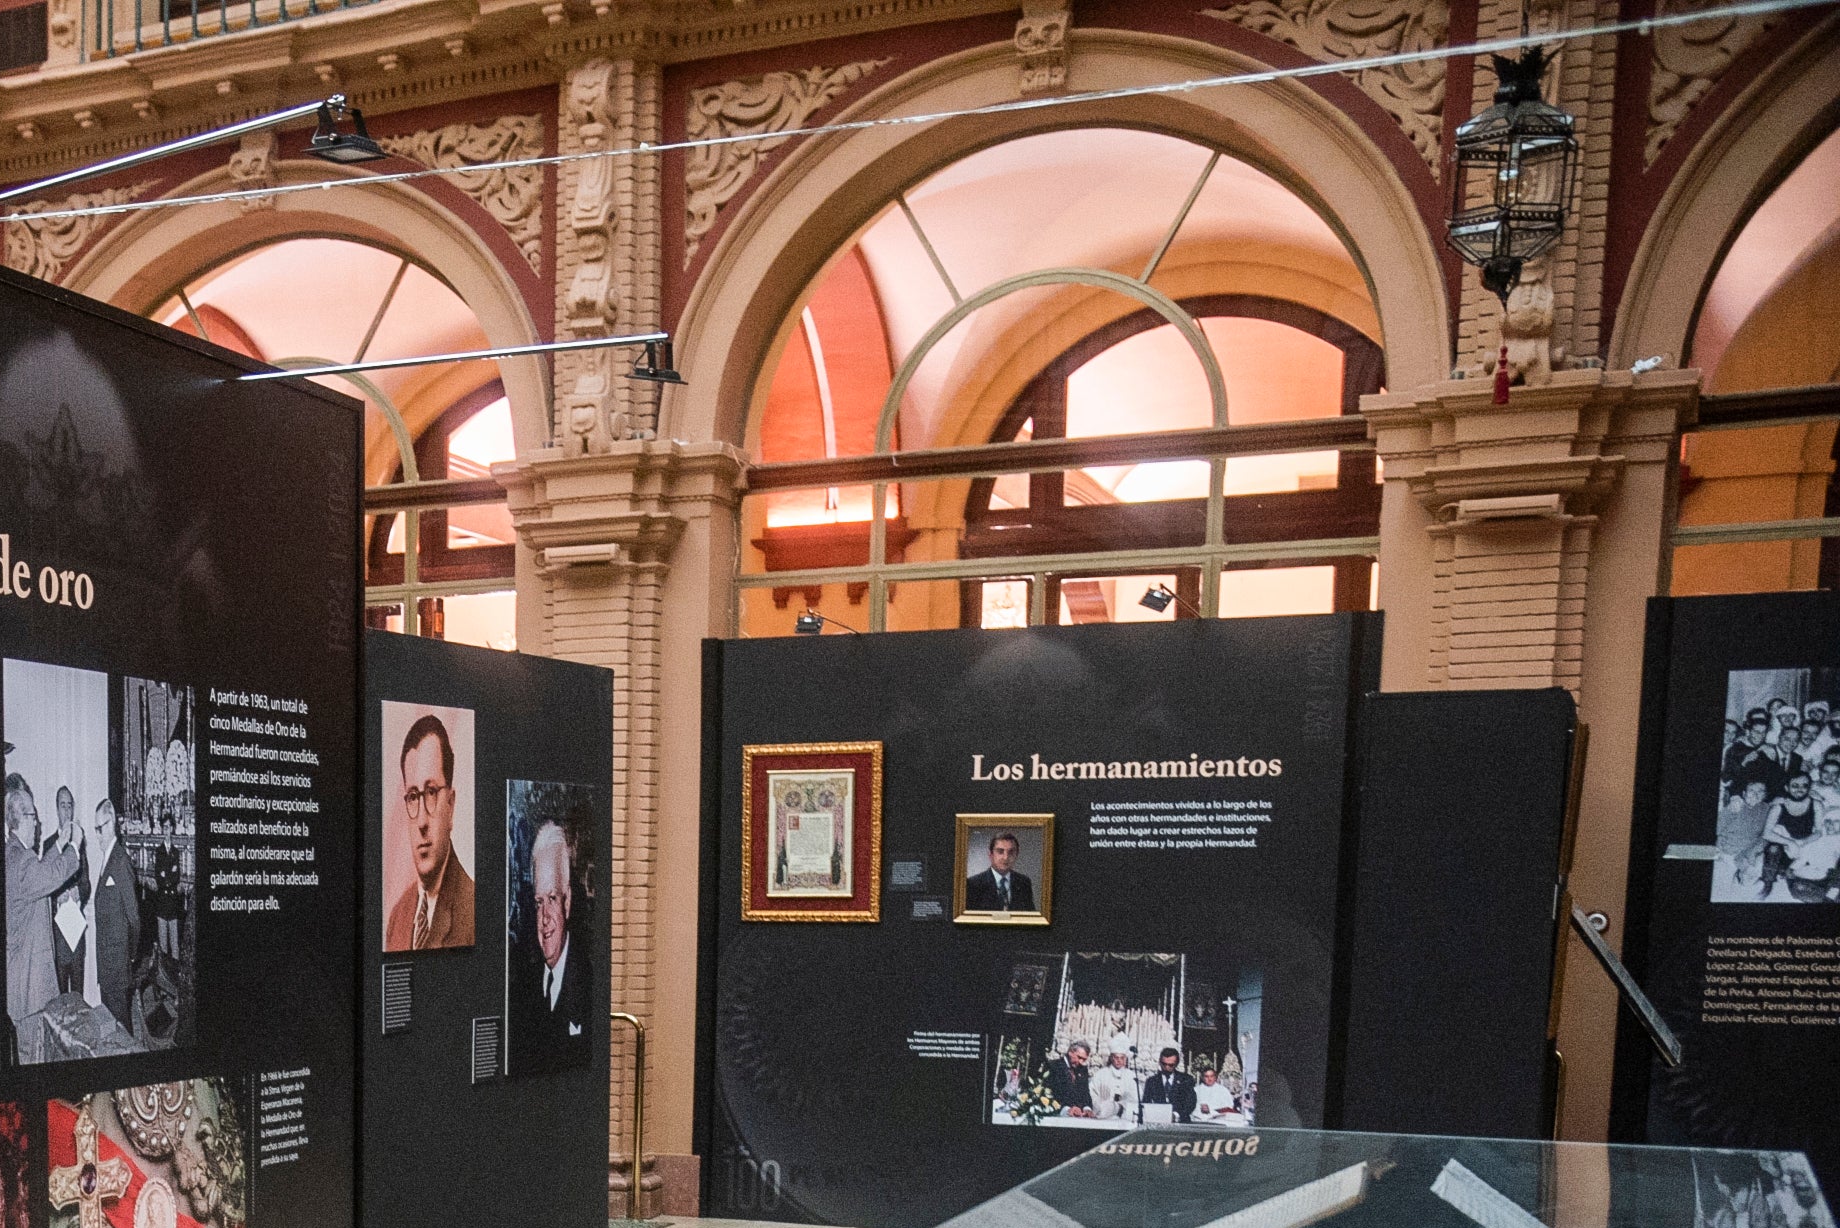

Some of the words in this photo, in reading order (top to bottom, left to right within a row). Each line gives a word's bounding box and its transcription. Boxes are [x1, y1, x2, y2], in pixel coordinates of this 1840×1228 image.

[39, 565, 94, 609] oro
[210, 688, 216, 702] A
[218, 691, 238, 706] partir
[239, 692, 249, 707] de
[251, 694, 270, 711] 1963,
[271, 699, 280, 710] un
[282, 699, 297, 713] total
[299, 700, 308, 715] de
[210, 715, 230, 730] cinco
[232, 717, 264, 734] Medallas
[265, 721, 274, 735] de
[276, 722, 288, 737] Oro
[290, 723, 299, 738] de
[300, 724, 306, 739] la
[210, 740, 254, 759] Hermandad
[255, 744, 278, 760] fueron
[280, 749, 320, 766] concedidas,
[971, 755, 1024, 781] Los
[1030, 753, 1283, 780] hermanamientos
[210, 768, 258, 784] premiándose
[260, 771, 269, 784] así
[271, 771, 281, 786] los
[282, 774, 311, 788] servicios
[210, 794, 265, 810] extraordinarios
[266, 799, 271, 813] y
[272, 798, 320, 815] excepcionales
[1091, 801, 1105, 810] Los
[1106, 801, 1174, 810] acontecimientos
[1176, 800, 1205, 810] vividos
[1213, 800, 1222, 809] lo
[1223, 800, 1245, 811] largo
[1247, 800, 1258, 809] de
[1260, 800, 1272, 809] los
[1091, 814, 1110, 823] años
[1128, 815, 1149, 823] otras
[1150, 814, 1207, 822] hermandades
[1216, 813, 1272, 822] instituciones,
[211, 819, 248, 834] realizados
[249, 824, 258, 835] en
[260, 820, 291, 836] beneficio
[293, 822, 302, 836] de
[303, 822, 309, 836] la
[1090, 826, 1106, 835] han
[1107, 826, 1129, 835] dado
[1130, 826, 1151, 837] lugar
[1182, 826, 1222, 835] estrechos
[1223, 826, 1245, 835] lazos
[1246, 826, 1258, 834] de
[1090, 839, 1113, 848] unión
[1115, 840, 1137, 848] entre
[1138, 839, 1159, 848] éstas
[1160, 841, 1166, 849] y
[1167, 839, 1175, 848] la
[1176, 839, 1204, 850] propia
[1205, 838, 1257, 848] Hermandad.
[211, 845, 238, 861] misma,
[239, 845, 245, 859] al
[246, 846, 290, 860] considerarse
[291, 849, 305, 864] que
[306, 847, 315, 861] tal
[211, 870, 243, 889] galardón
[245, 871, 262, 885] sería
[263, 870, 269, 885] la
[271, 871, 284, 885] más
[286, 871, 319, 885] adecuada
[211, 896, 247, 911] distinción
[248, 899, 264, 914] para
[265, 896, 280, 910] ello.
[1709, 936, 1724, 945] Los
[1727, 937, 1770, 945] nombres
[1772, 936, 1784, 945] de
[1787, 936, 1833, 945] Palomino
[1707, 949, 1747, 958] Orellana
[1750, 949, 1793, 959] Delgado,
[1795, 950, 1834, 958] Esteban
[1706, 962, 1735, 971] López
[1774, 962, 1808, 971] Gómez
[1705, 975, 1739, 985] Vargas,
[1742, 975, 1781, 984] Jiménez
[1704, 988, 1716, 997] de
[1719, 988, 1727, 997] la
[1758, 989, 1791, 997] Alonso
[1816, 1002, 1829, 1011] de
[1702, 1014, 1745, 1023] Esquivias
